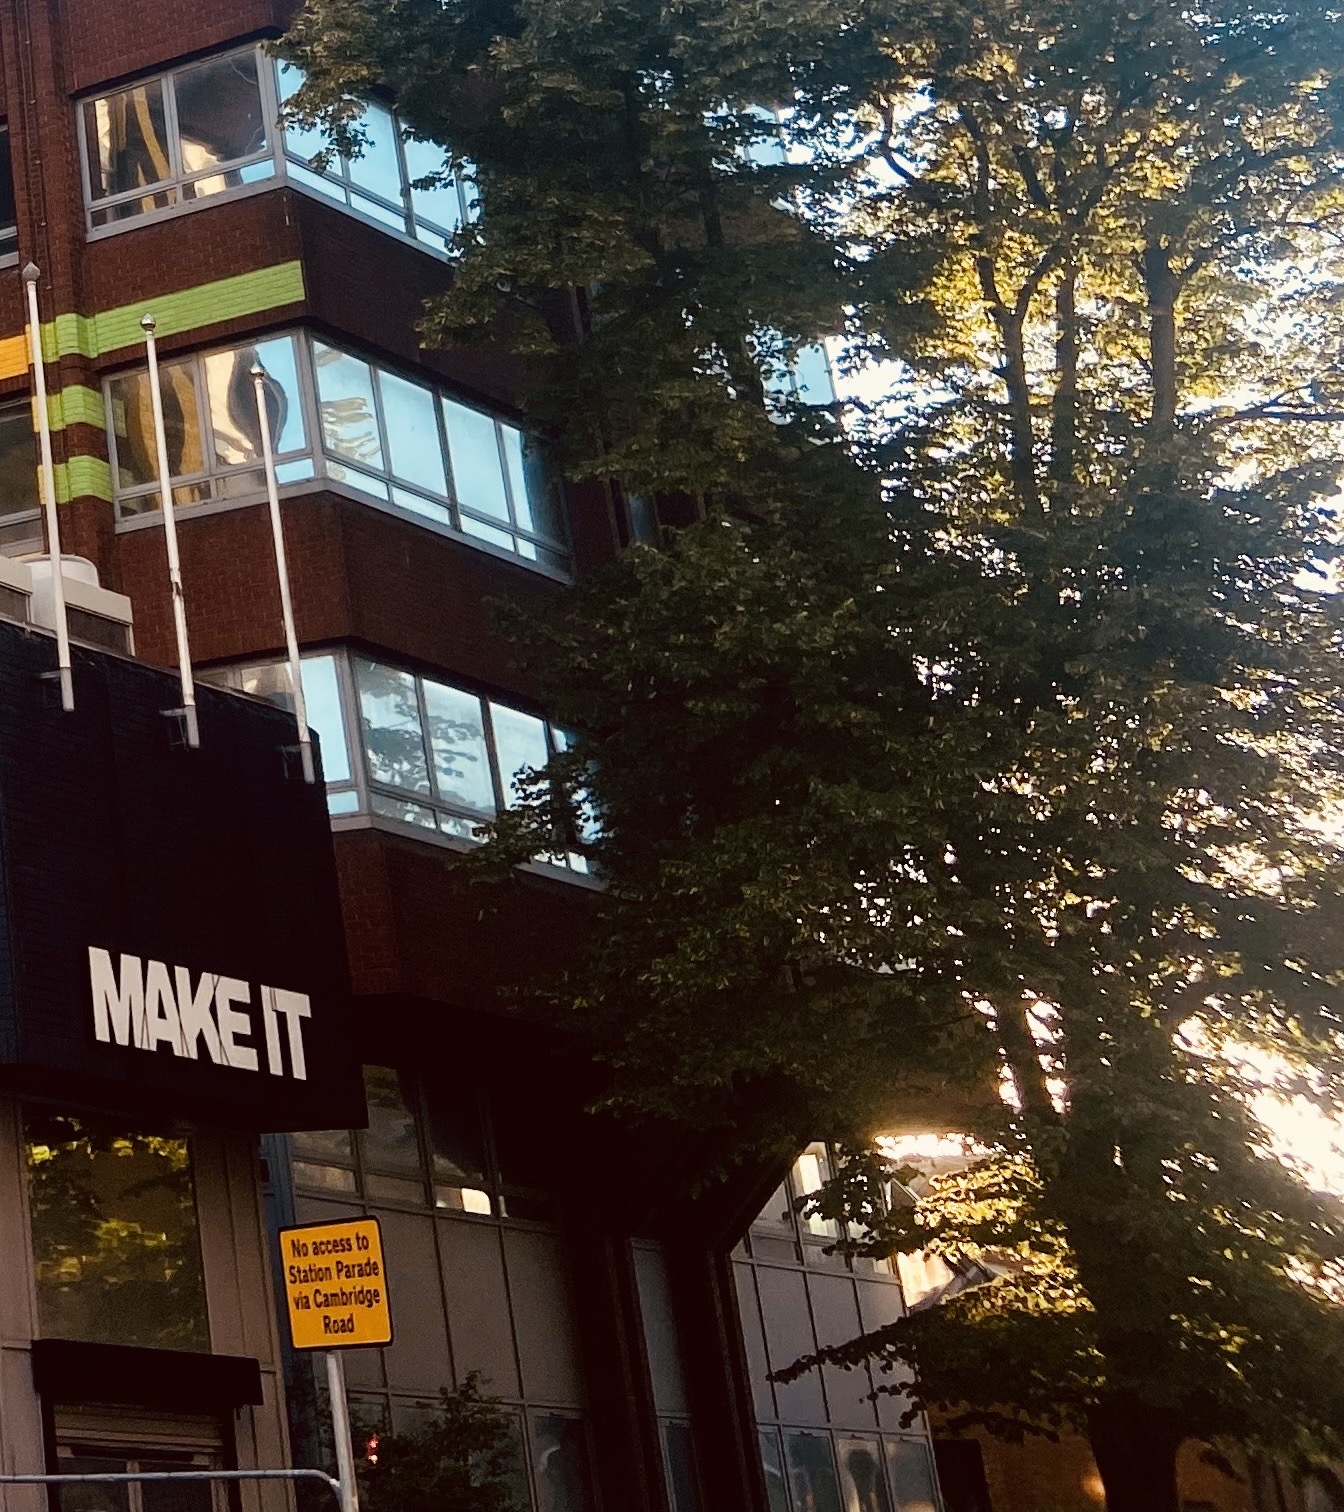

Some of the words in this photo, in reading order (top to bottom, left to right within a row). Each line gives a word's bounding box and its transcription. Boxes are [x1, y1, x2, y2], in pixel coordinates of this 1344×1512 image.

[88, 946, 258, 1071] MAKE
[260, 984, 311, 1080] IT
[290, 1239, 309, 1257] No
[312, 1237, 353, 1255] access
[355, 1232, 369, 1251] to
[288, 1263, 333, 1284] Station
[335, 1257, 380, 1280] Parade
[293, 1291, 311, 1310] via
[313, 1285, 381, 1308] Cambridge
[322, 1313, 356, 1334] Road
